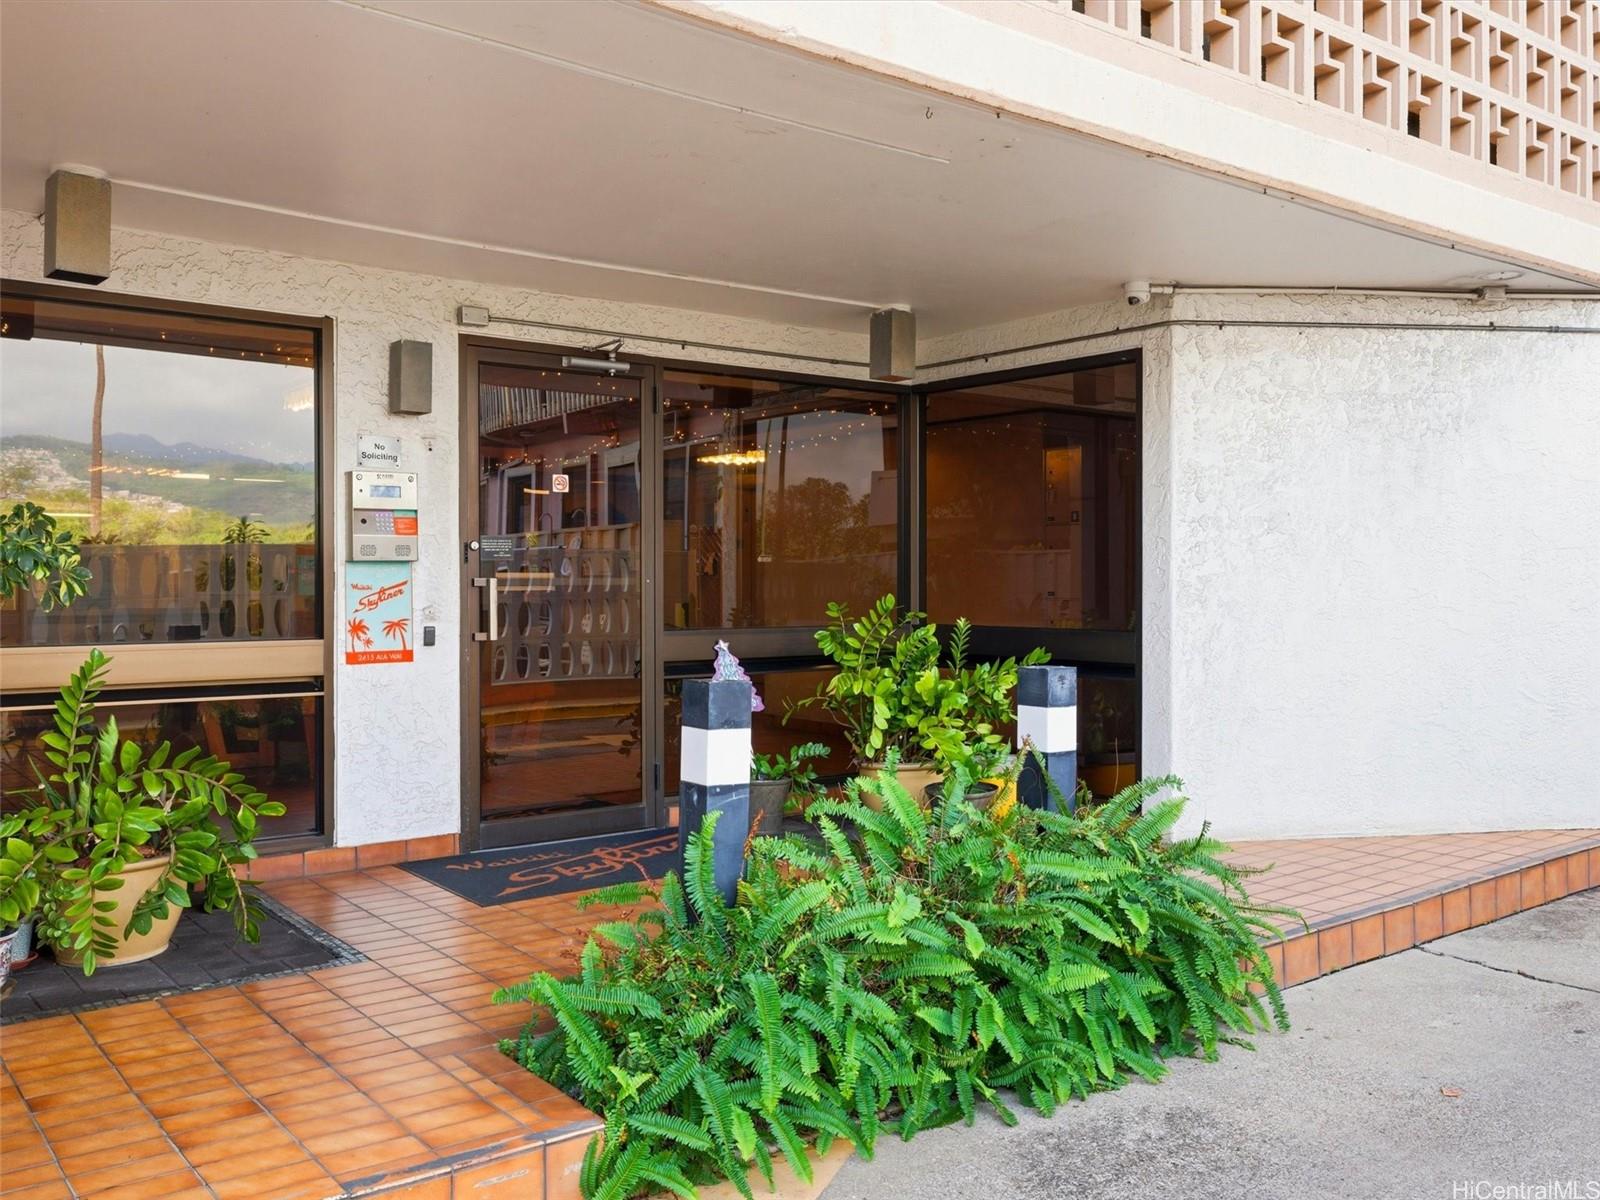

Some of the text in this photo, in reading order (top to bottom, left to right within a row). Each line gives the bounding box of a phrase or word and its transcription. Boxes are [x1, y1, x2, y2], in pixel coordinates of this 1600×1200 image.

[374, 443, 386, 451] No
[361, 451, 398, 462] Soliciting
[445, 850, 572, 872] Waikiki
